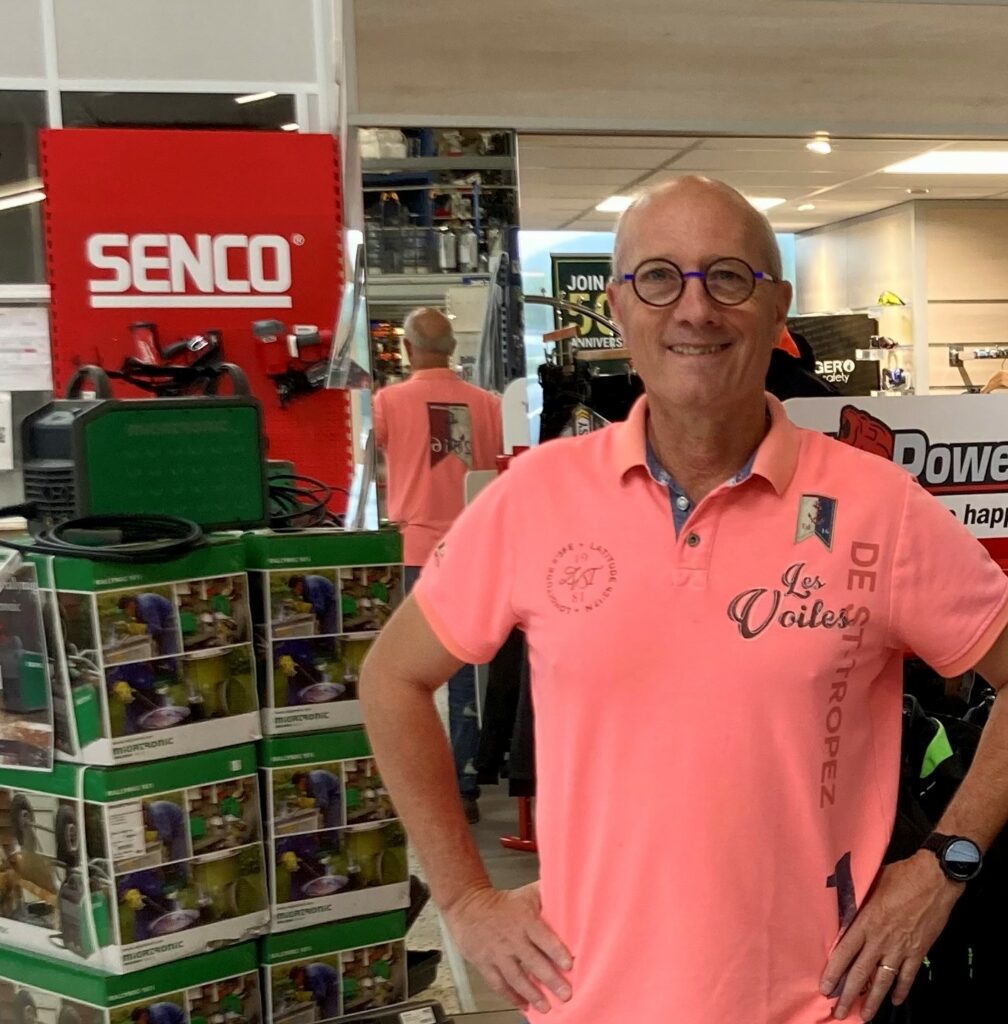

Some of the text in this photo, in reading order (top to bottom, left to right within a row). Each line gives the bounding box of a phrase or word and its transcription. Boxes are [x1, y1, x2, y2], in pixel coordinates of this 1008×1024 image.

[88, 233, 292, 293] SENCO
[567, 275, 604, 291] JOIN
[781, 562, 826, 599] Les
[847, 541, 879, 592] DE
[727, 587, 854, 639] Voiles
